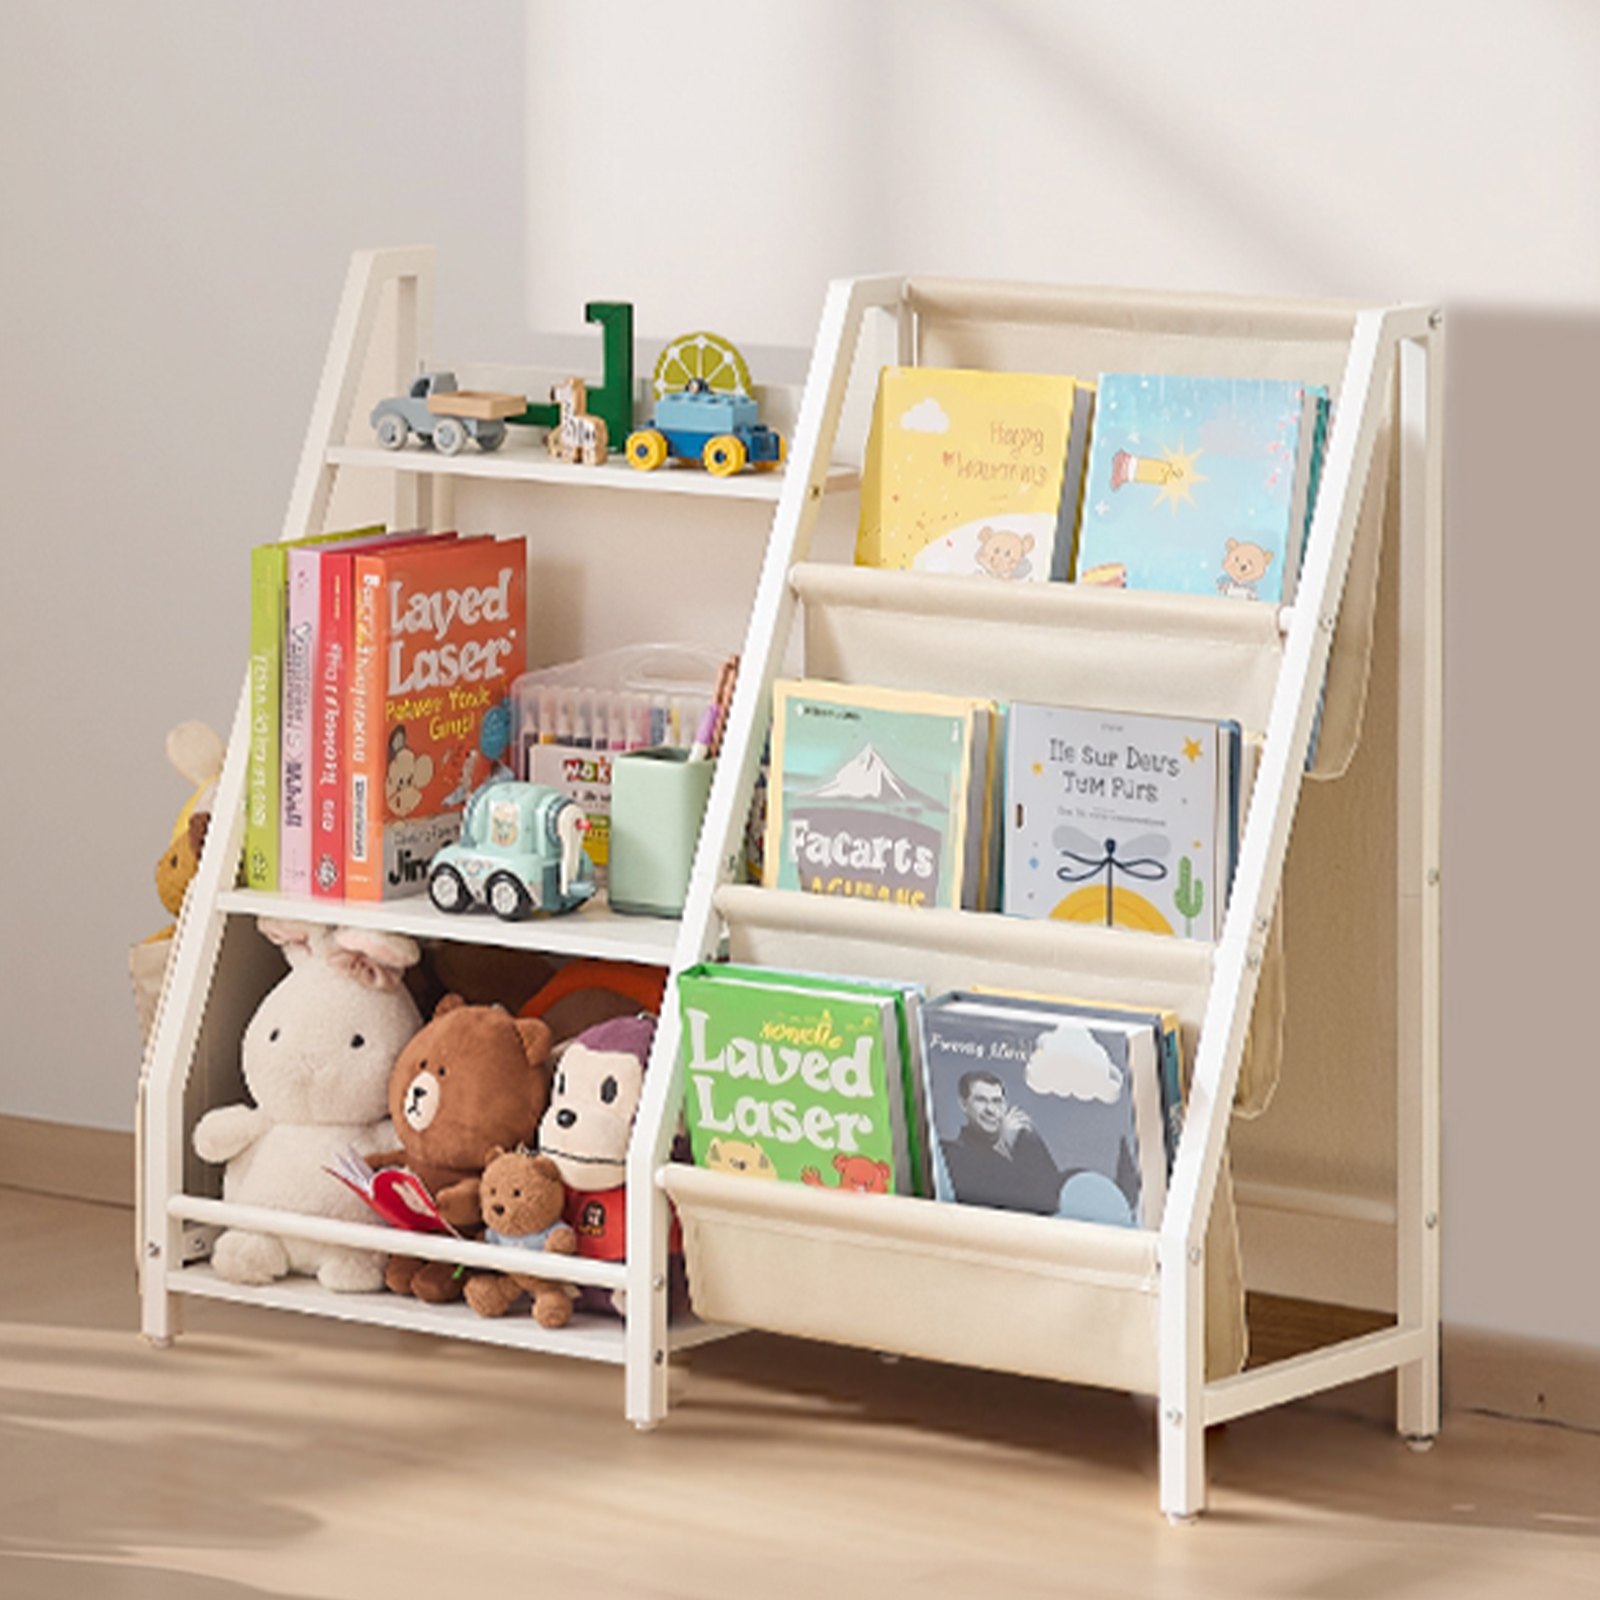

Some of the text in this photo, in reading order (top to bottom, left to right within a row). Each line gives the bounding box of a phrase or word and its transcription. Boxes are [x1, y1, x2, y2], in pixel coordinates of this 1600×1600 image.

[388, 566, 513, 642] Layed
[788, 818, 936, 879] Facarts
[685, 1006, 875, 1098] Laved
[691, 1073, 874, 1153] Laser
